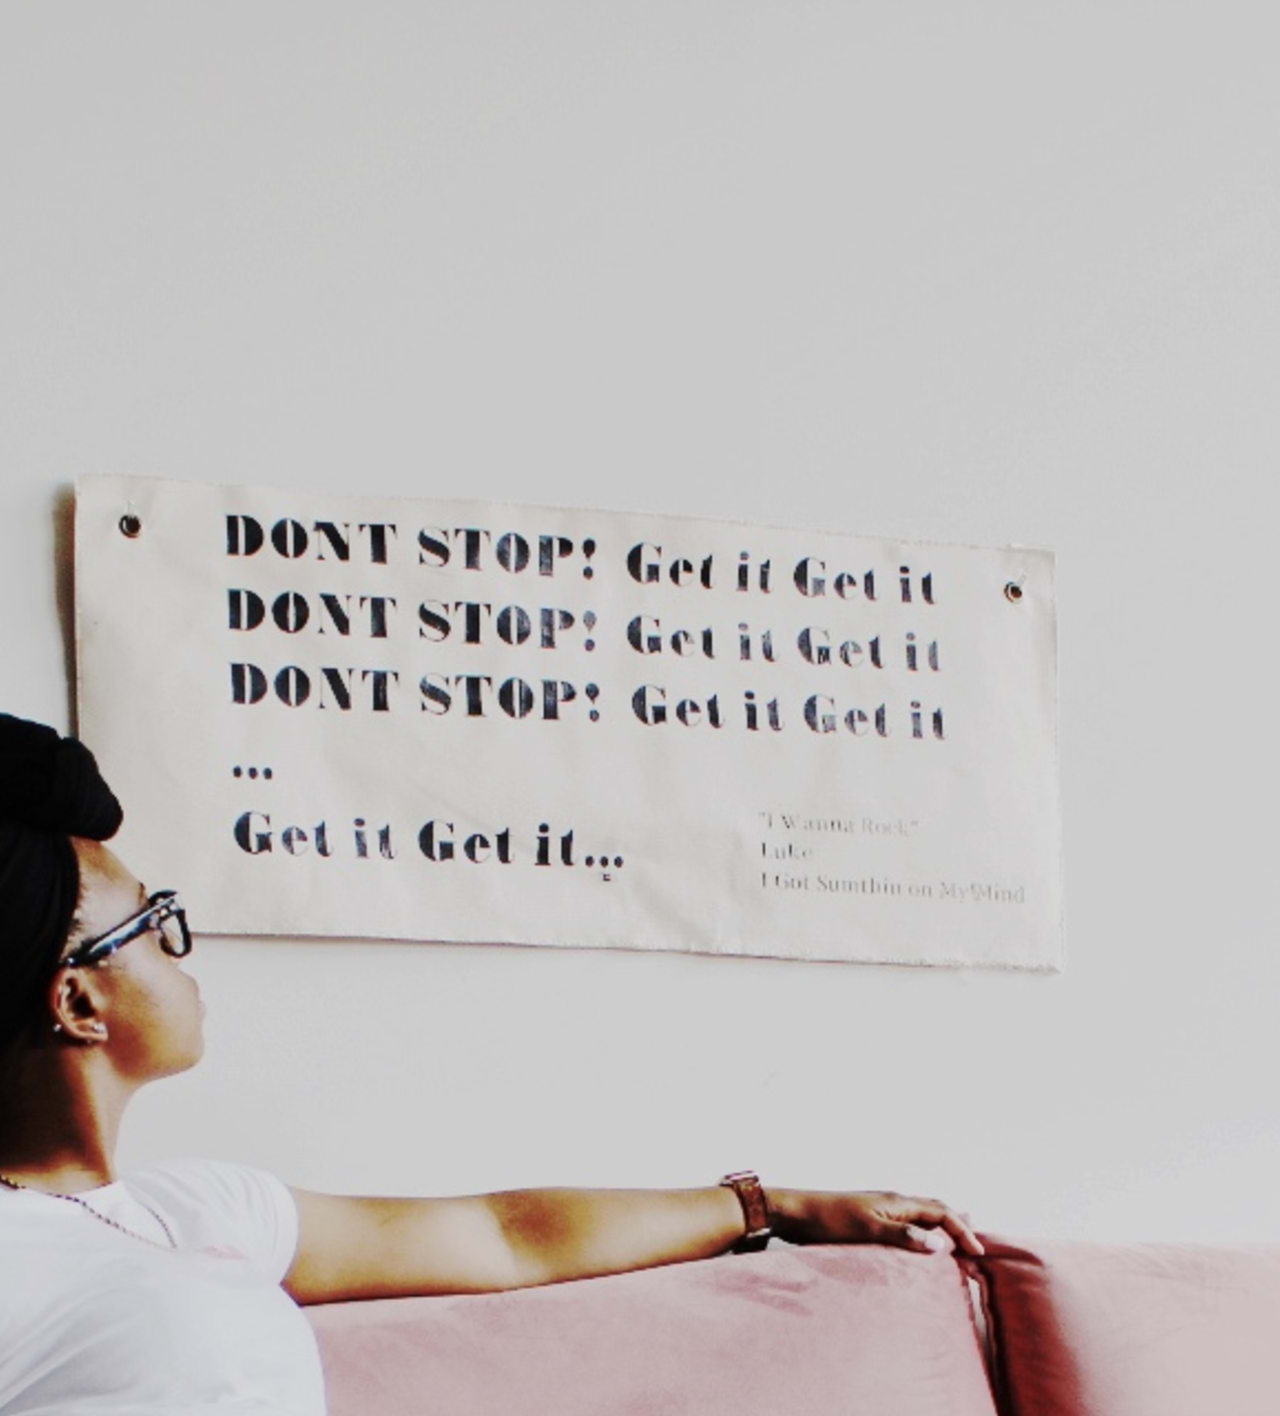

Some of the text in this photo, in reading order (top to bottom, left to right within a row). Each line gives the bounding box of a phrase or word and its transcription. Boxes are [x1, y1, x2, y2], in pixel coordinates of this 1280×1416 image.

[225, 514, 935, 605] DONT STOP! Get it Get it
[227, 588, 939, 672] DONT STOP! Get it Get it
[230, 662, 944, 740] DONT STOP! Get it Get it
[233, 811, 331, 858] Get
[353, 817, 395, 860] it
[417, 820, 512, 865] Get
[775, 874, 809, 891] Got
[816, 873, 901, 896] Sumthin
[908, 883, 931, 898] on
